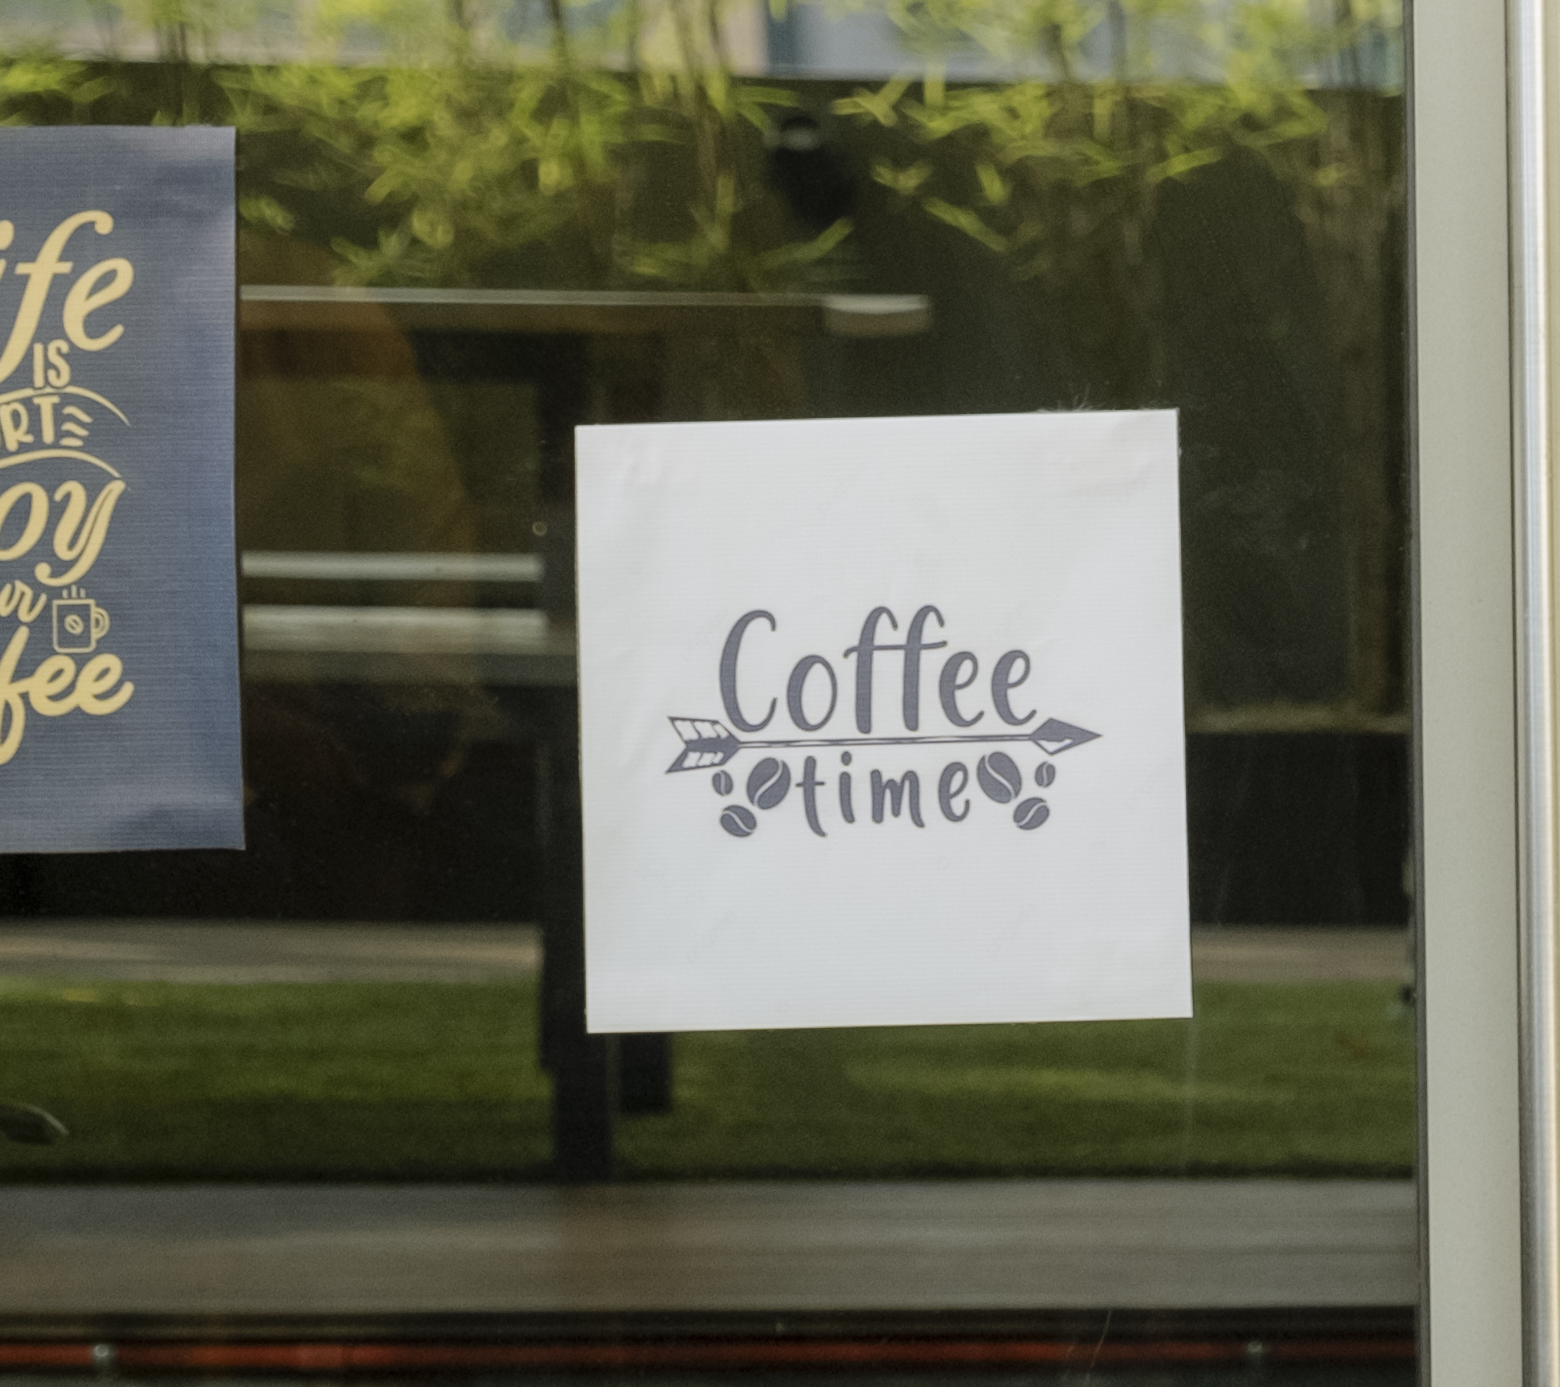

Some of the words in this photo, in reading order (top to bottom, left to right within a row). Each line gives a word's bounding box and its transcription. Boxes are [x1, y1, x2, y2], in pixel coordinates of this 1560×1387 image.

[33, 339, 71, 389] IS
[718, 604, 1038, 735] Coffee
[795, 751, 971, 838] time
